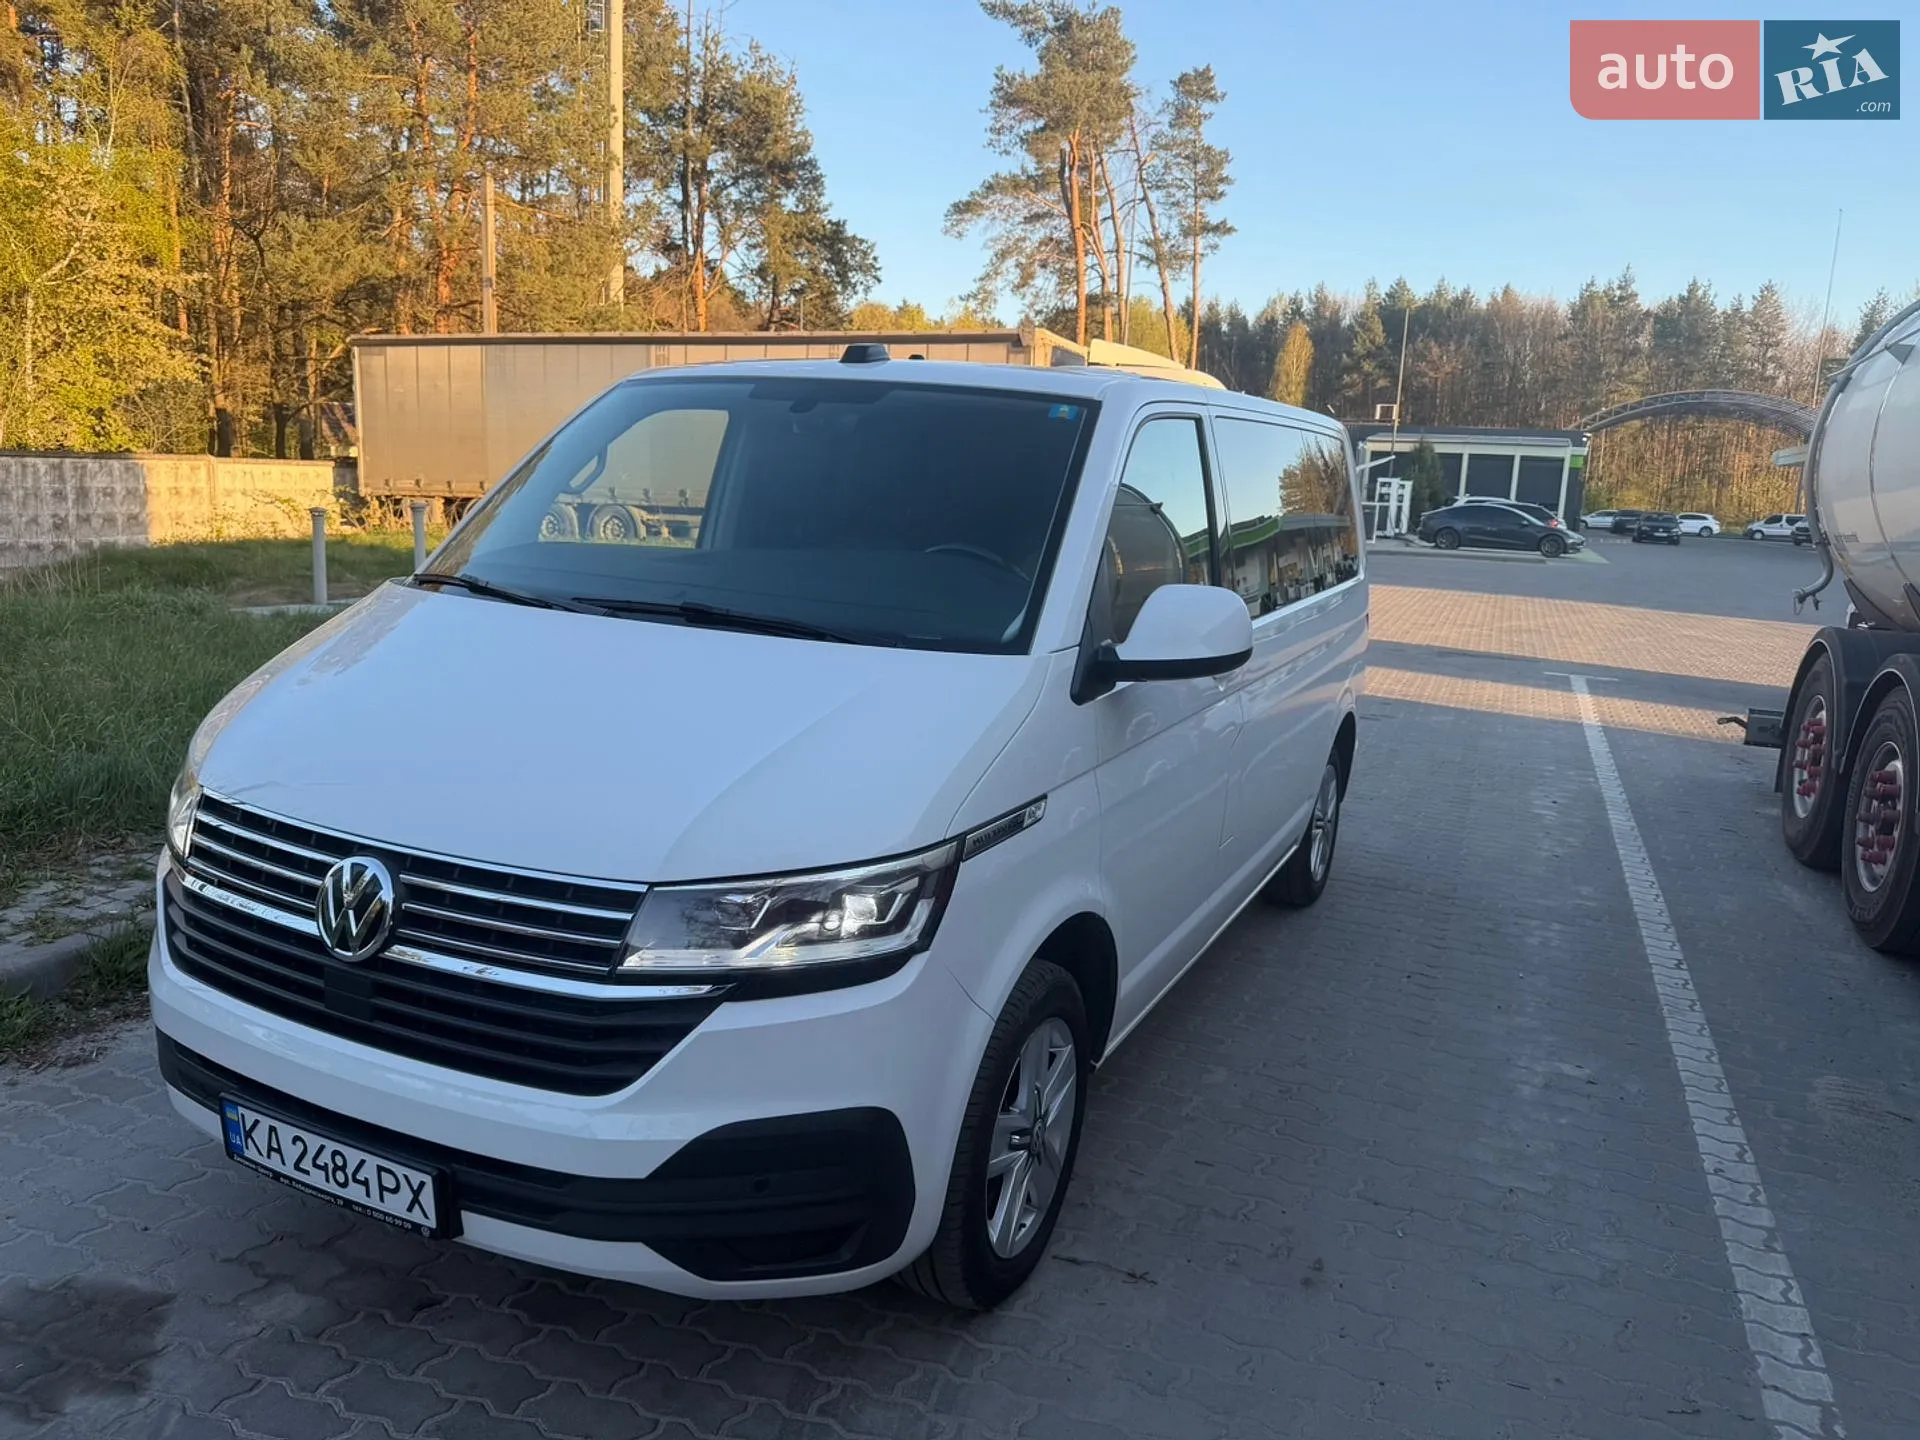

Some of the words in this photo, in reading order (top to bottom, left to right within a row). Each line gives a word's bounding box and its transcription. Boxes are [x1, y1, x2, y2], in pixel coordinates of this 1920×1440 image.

[229, 1132, 242, 1146] UA
[240, 1112, 287, 1166] KA
[291, 1134, 371, 1199] 2484
[376, 1163, 431, 1221] PX
